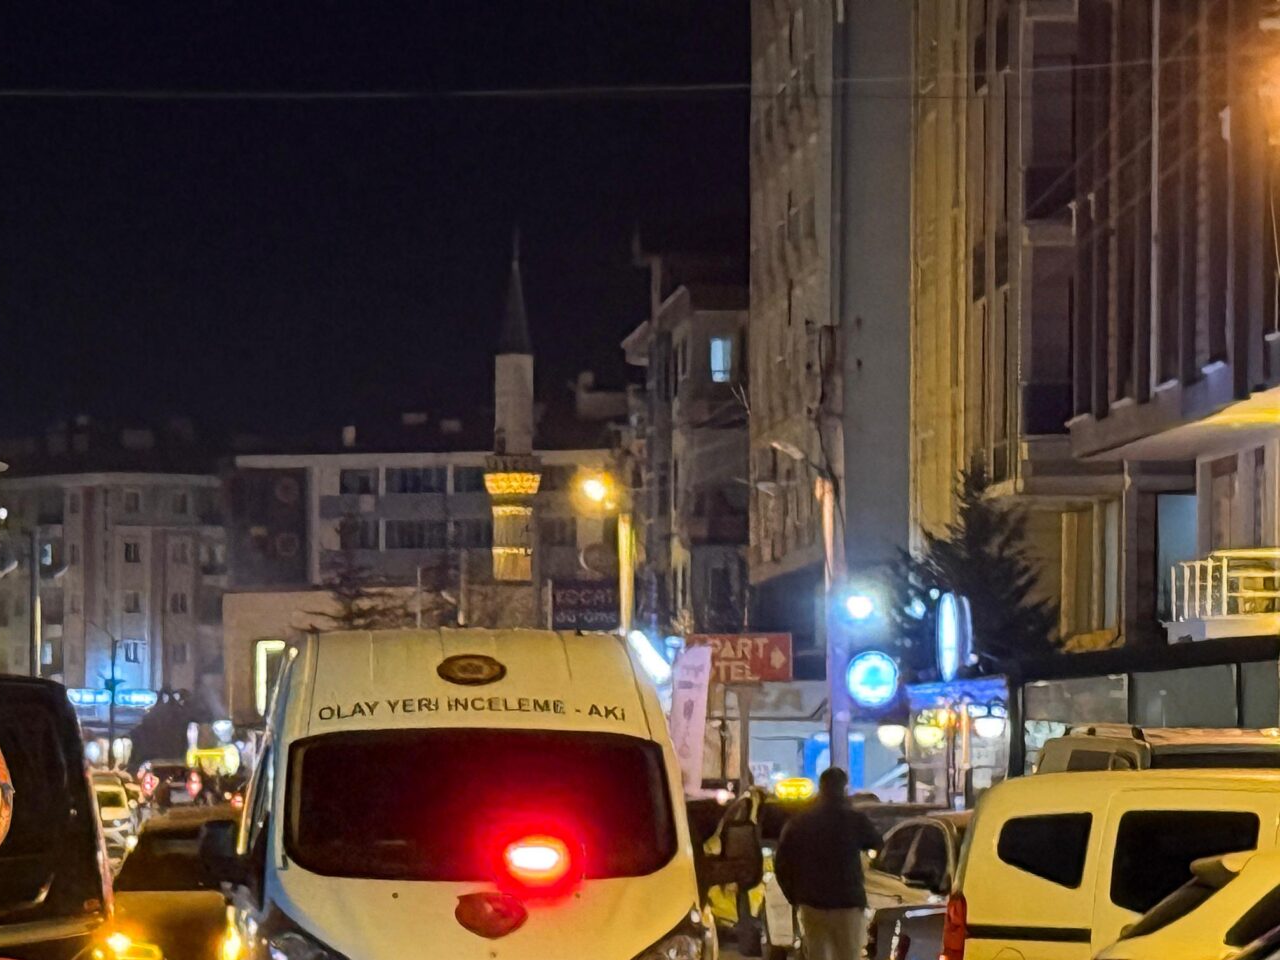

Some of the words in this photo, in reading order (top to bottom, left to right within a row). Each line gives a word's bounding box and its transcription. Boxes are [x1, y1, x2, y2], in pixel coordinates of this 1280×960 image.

[694, 637, 769, 659] PART
[713, 660, 761, 682] TEL
[318, 701, 379, 720] OLAY
